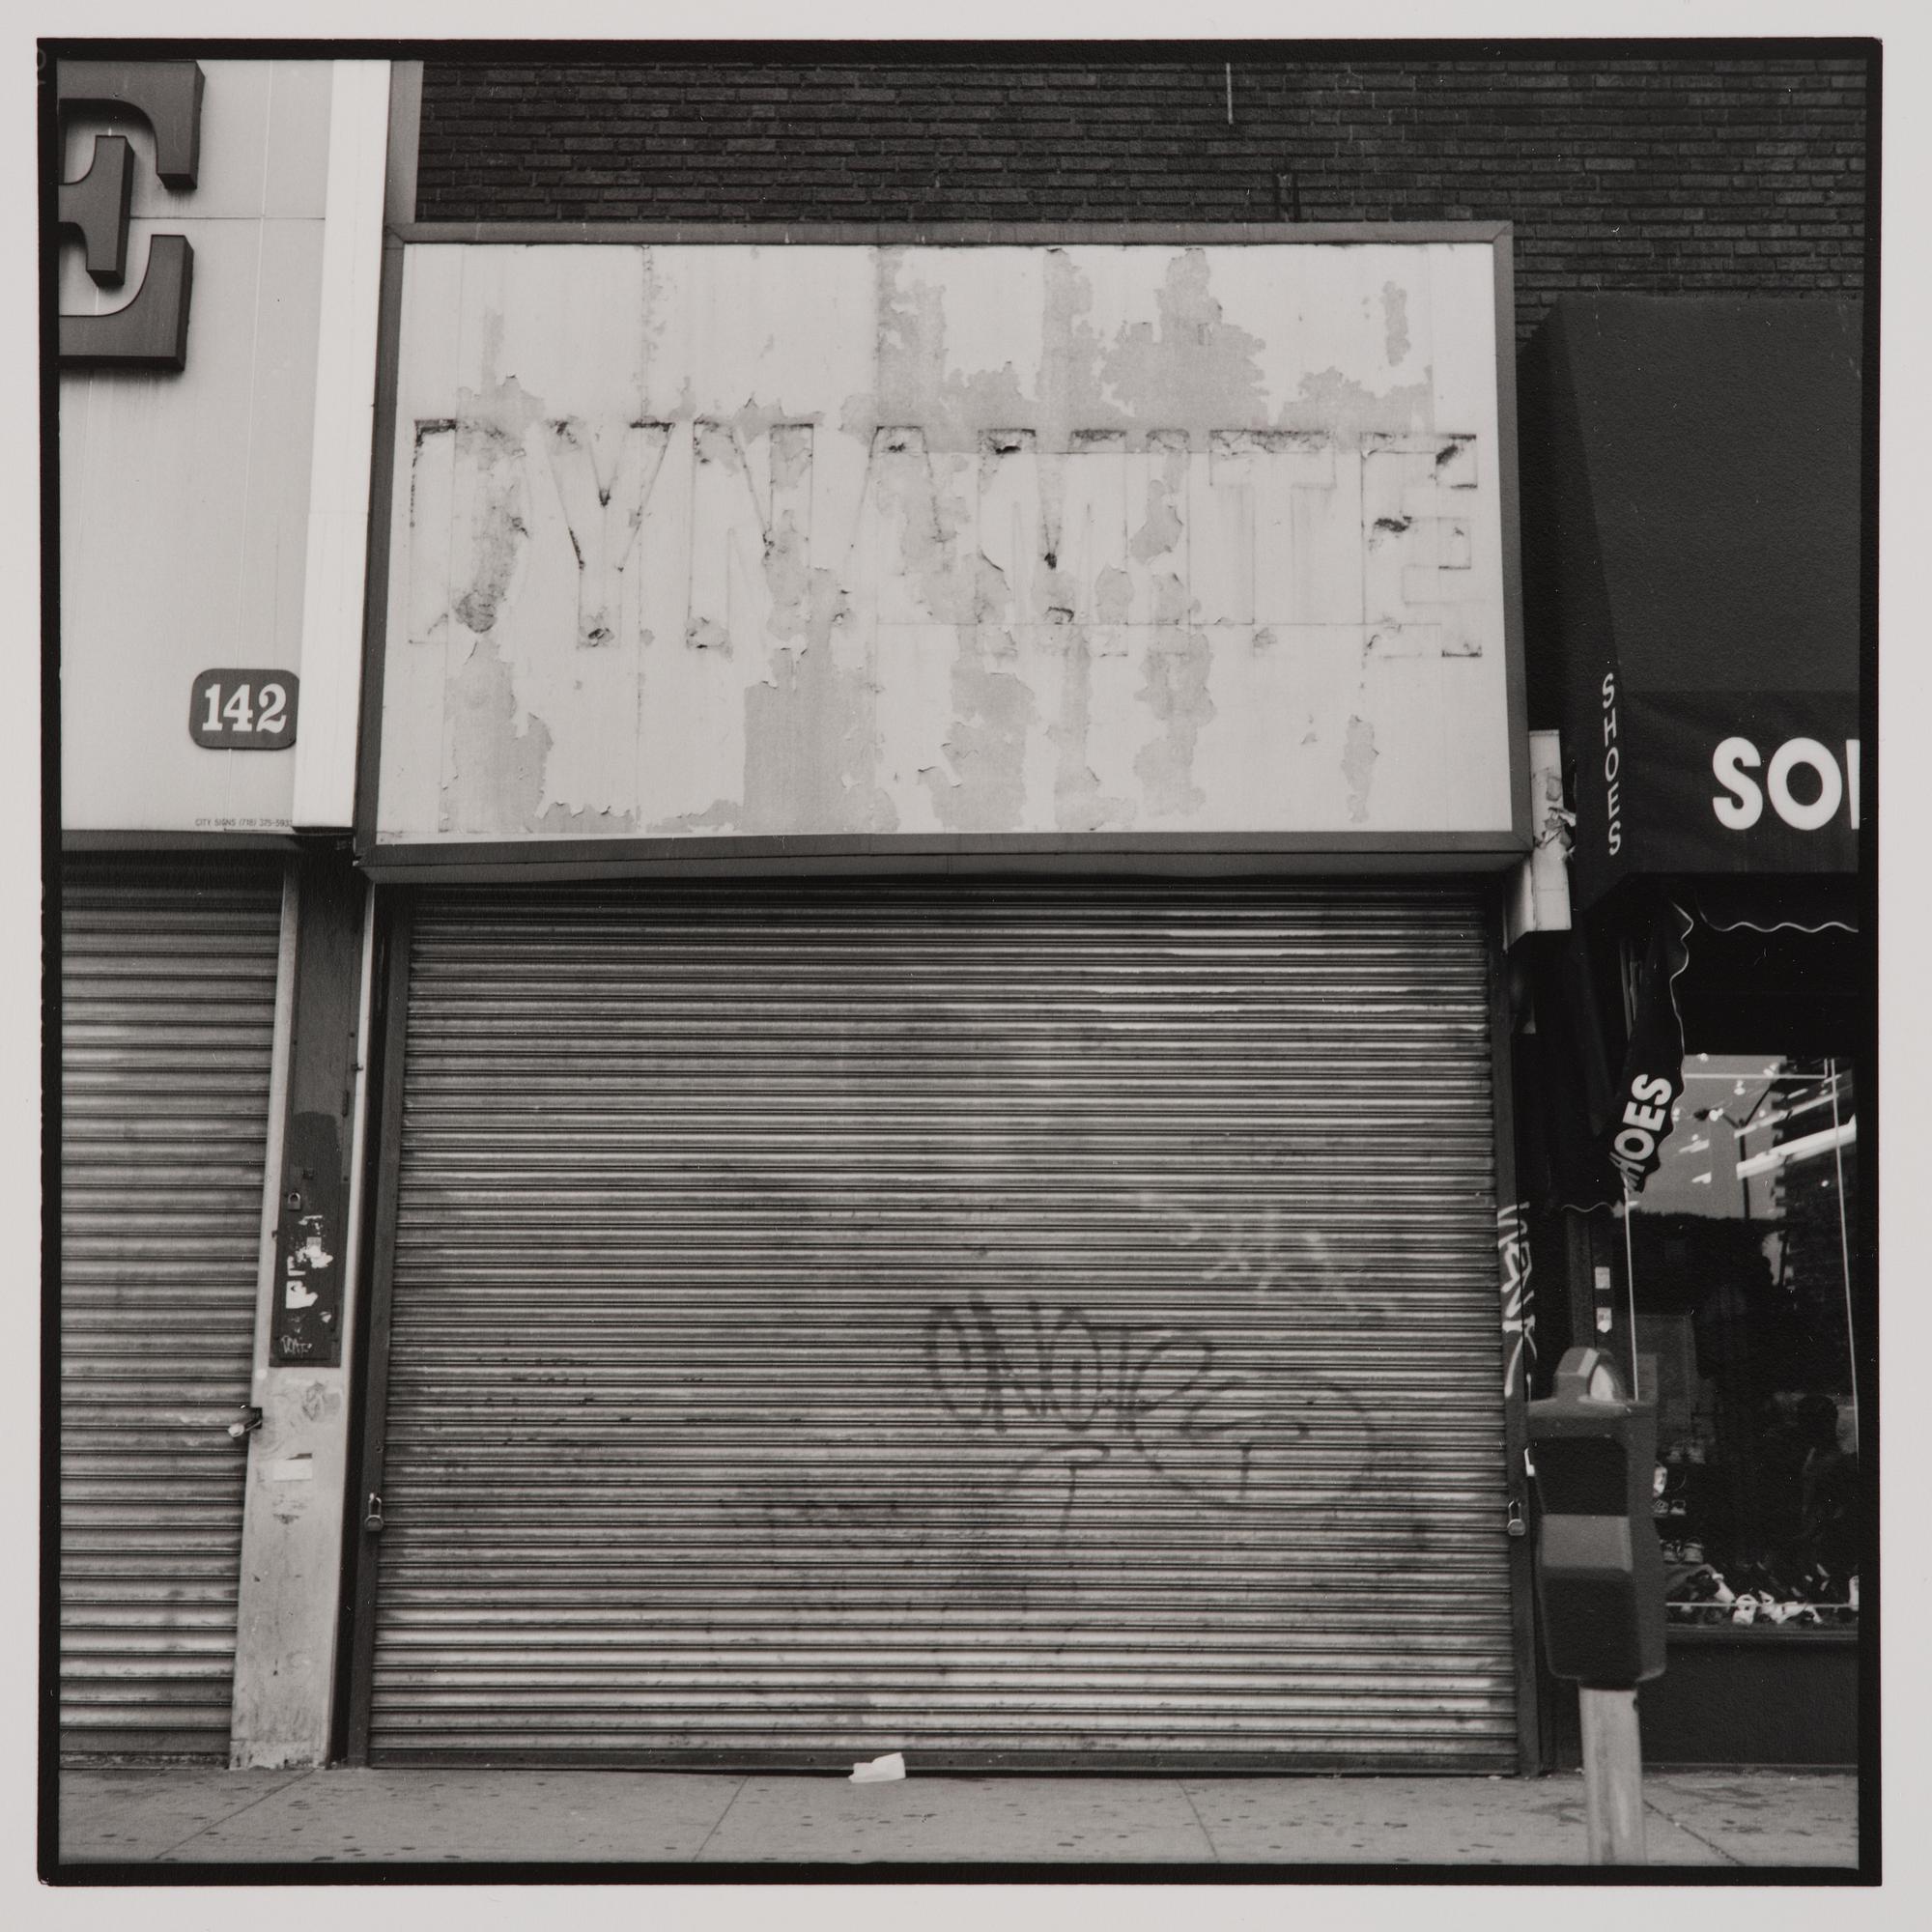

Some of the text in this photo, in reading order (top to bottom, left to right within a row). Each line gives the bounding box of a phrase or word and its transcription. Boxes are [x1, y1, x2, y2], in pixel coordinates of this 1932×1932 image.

[202, 682, 287, 734] 142
[1600, 672, 1622, 857] SHOES
[1712, 736, 1861, 831] SO
[194, 817, 212, 827] CITY
[214, 817, 237, 827] SIGNS
[1608, 1074, 1673, 1190] HOES
